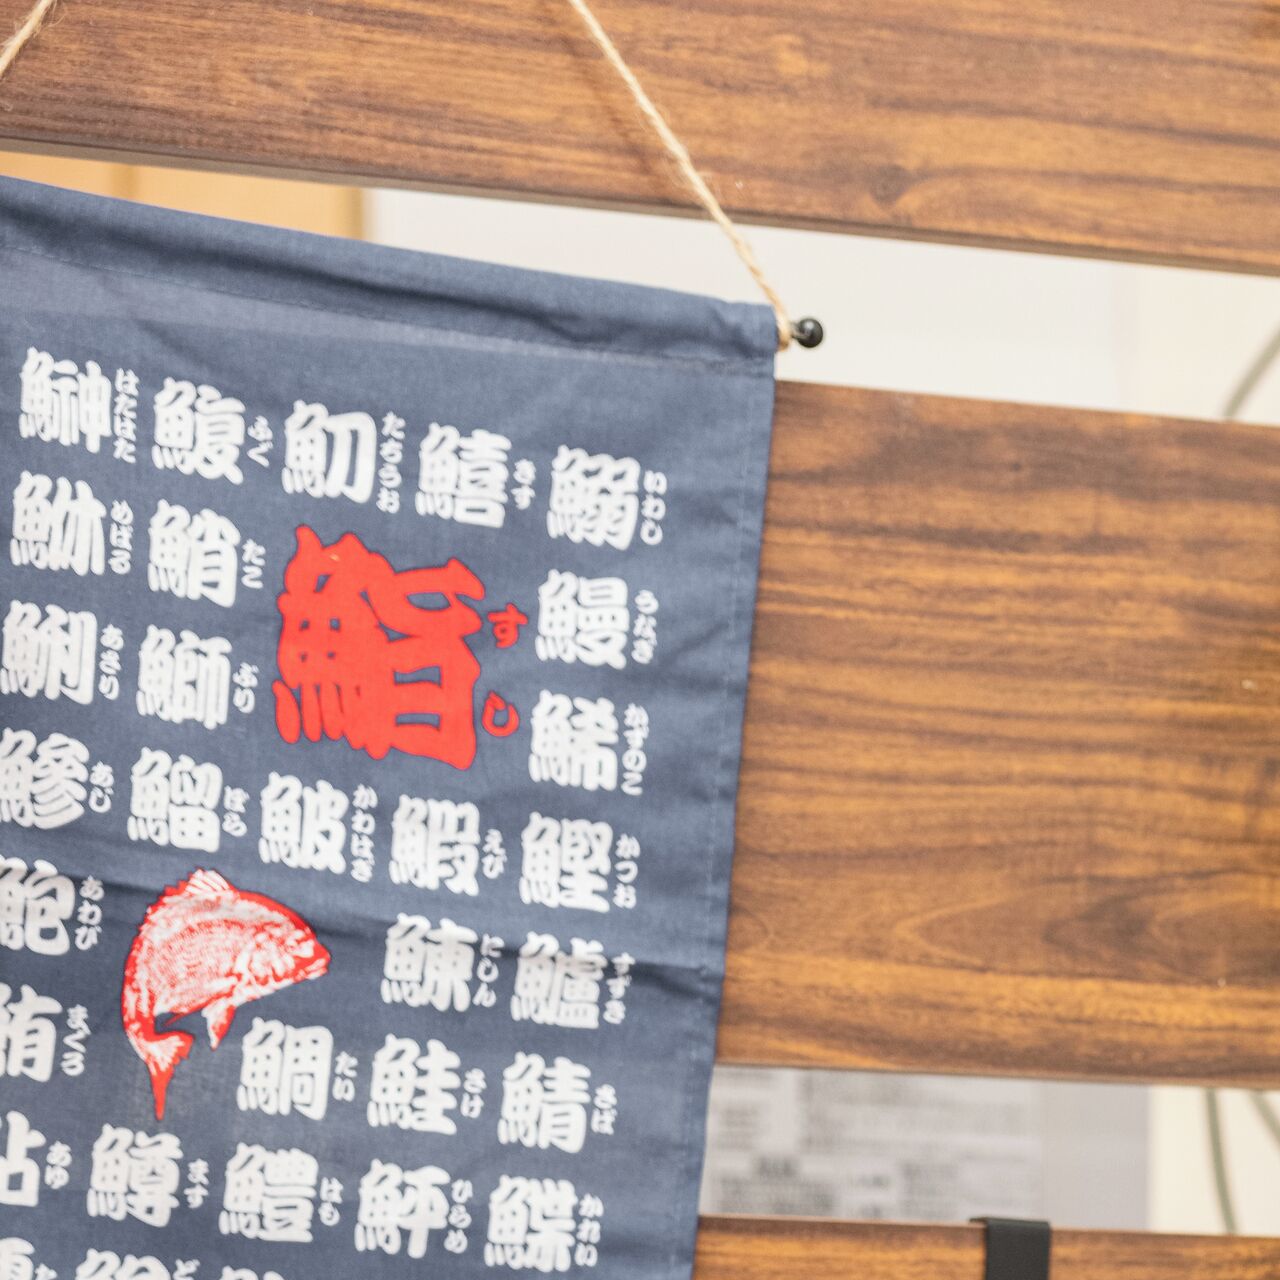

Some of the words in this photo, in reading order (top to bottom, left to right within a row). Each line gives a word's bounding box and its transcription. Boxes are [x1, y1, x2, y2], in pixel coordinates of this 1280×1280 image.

[18, 346, 113, 454] 鰰
[112, 367, 140, 464] はたはた
[246, 415, 274, 468] ふぐ
[375, 411, 406, 514] たちうお
[414, 422, 513, 529] 鱚
[510, 458, 537, 510] きす
[546, 444, 641, 551] 鰯
[639, 470, 668, 546] いわし
[107, 499, 134, 575] めばる
[241, 538, 266, 590] たこ
[534, 568, 631, 670] 鰻
[631, 589, 660, 664] うなぎ
[98, 623, 125, 701] あさり
[135, 624, 233, 731] 鰤
[232, 662, 259, 714] ぶり
[482, 604, 528, 737] すし
[88, 760, 115, 814] あじ
[620, 702, 650, 796] かずのこ
[221, 785, 250, 838] ぼら
[350, 783, 378, 883] かわはぎ
[481, 828, 508, 880] えび
[518, 811, 614, 914] 鰹
[612, 833, 641, 910] かつお
[74, 875, 104, 951] あわび
[472, 933, 505, 1008] にしん
[510, 930, 608, 1030] 鱸
[602, 951, 636, 1025] すずき
[60, 1004, 91, 1077] まぐろ
[236, 1016, 334, 1121] 鯛
[331, 1050, 359, 1102] たい
[366, 1033, 462, 1136] 鮭
[460, 1067, 487, 1119] さけ
[497, 1051, 592, 1154] 鯖
[590, 1083, 618, 1136] さば
[44, 1141, 73, 1190] あゆ
[86, 1123, 184, 1227] 鱒
[183, 1158, 209, 1209] ます
[218, 1142, 320, 1243] 鱧
[318, 1176, 344, 1227] はも
[354, 1158, 451, 1259] 鮃
[444, 1179, 474, 1254] ひらめ
[483, 1174, 579, 1273] 鰈
[574, 1192, 605, 1267] かれい
